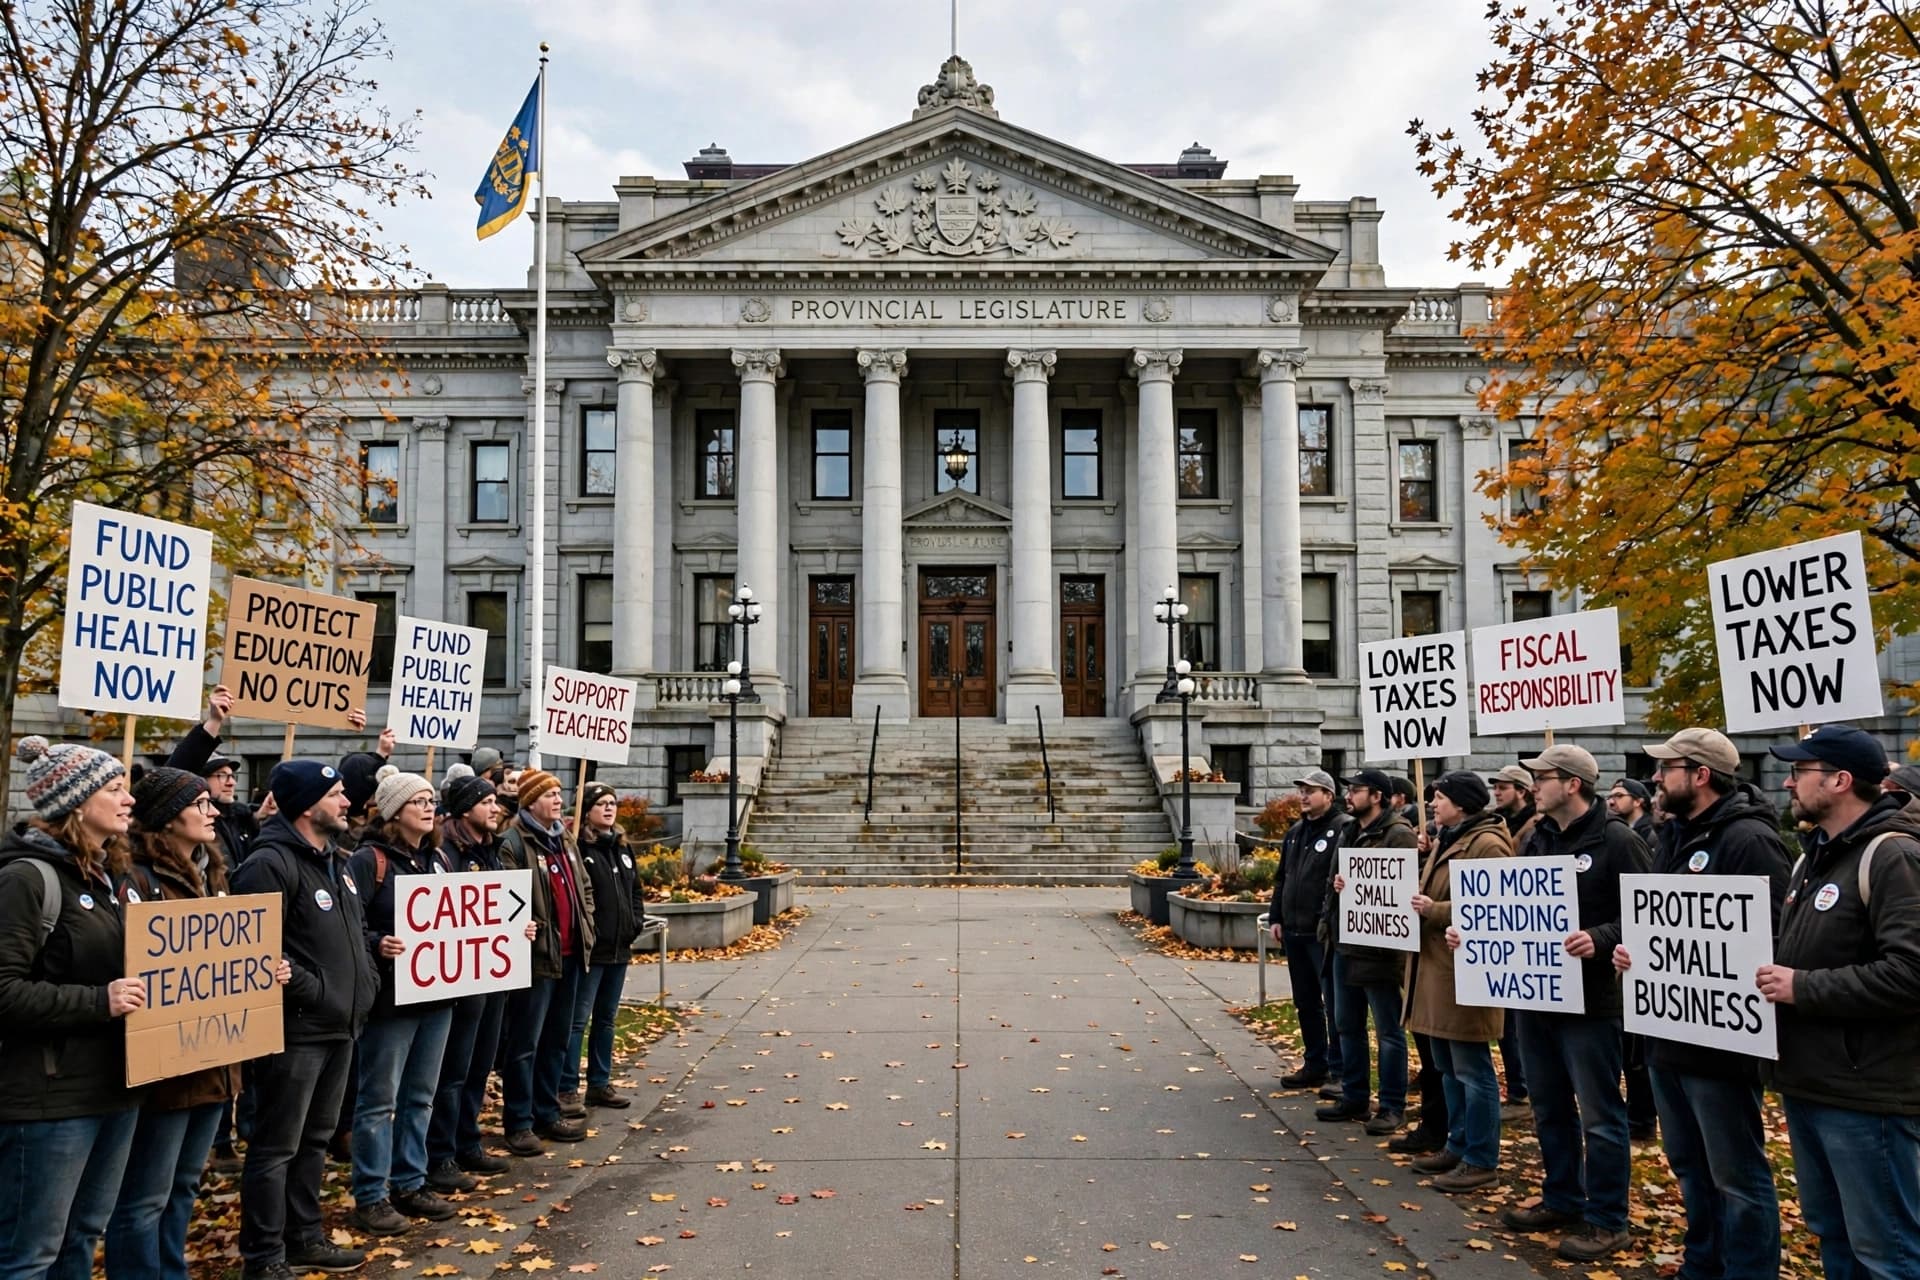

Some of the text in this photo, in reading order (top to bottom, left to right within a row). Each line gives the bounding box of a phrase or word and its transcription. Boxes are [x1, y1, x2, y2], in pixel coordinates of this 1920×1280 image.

[791, 299, 1128, 319] PROVINCIAL LEGISLATURE
[96, 520, 191, 570] FUND
[80, 564, 195, 617] PUBLIC
[1721, 551, 1852, 612] LOWER
[75, 611, 195, 661] HEALTH
[247, 593, 361, 640] PROTECT
[1726, 601, 1857, 661] TAXES
[413, 626, 471, 655] FUND
[1367, 643, 1455, 679] LOWER
[1500, 629, 1588, 671] FISCAL
[94, 660, 175, 704] NOW
[402, 655, 472, 685] PUBLIC
[1750, 658, 1845, 714] NOW
[239, 671, 351, 712] NO CUTS
[401, 685, 473, 713] HEALTH
[552, 677, 629, 712] SUPPORT
[1369, 678, 1457, 714] TAXES
[1480, 669, 1617, 715] RESPONSIBILITY
[410, 714, 461, 742] NOW
[546, 709, 628, 744] TEACHERS
[1384, 716, 1447, 749] NOW
[1349, 857, 1405, 881] PROTECT
[1460, 867, 1563, 898] NO MORE
[406, 883, 502, 933] CARE
[1355, 883, 1398, 908] SMALL
[1633, 888, 1754, 933] PROTECT
[147, 909, 267, 958] SUPPORT
[1347, 910, 1409, 938] BUSINESS
[1460, 903, 1569, 932] SPENDING
[411, 935, 512, 988] CUTS
[1466, 939, 1562, 968] STOP THE
[1648, 936, 1739, 980] SMALL
[139, 954, 273, 1010] TEACHERS
[1486, 972, 1563, 1003] WASTE
[1634, 980, 1762, 1034] BUSINESS
